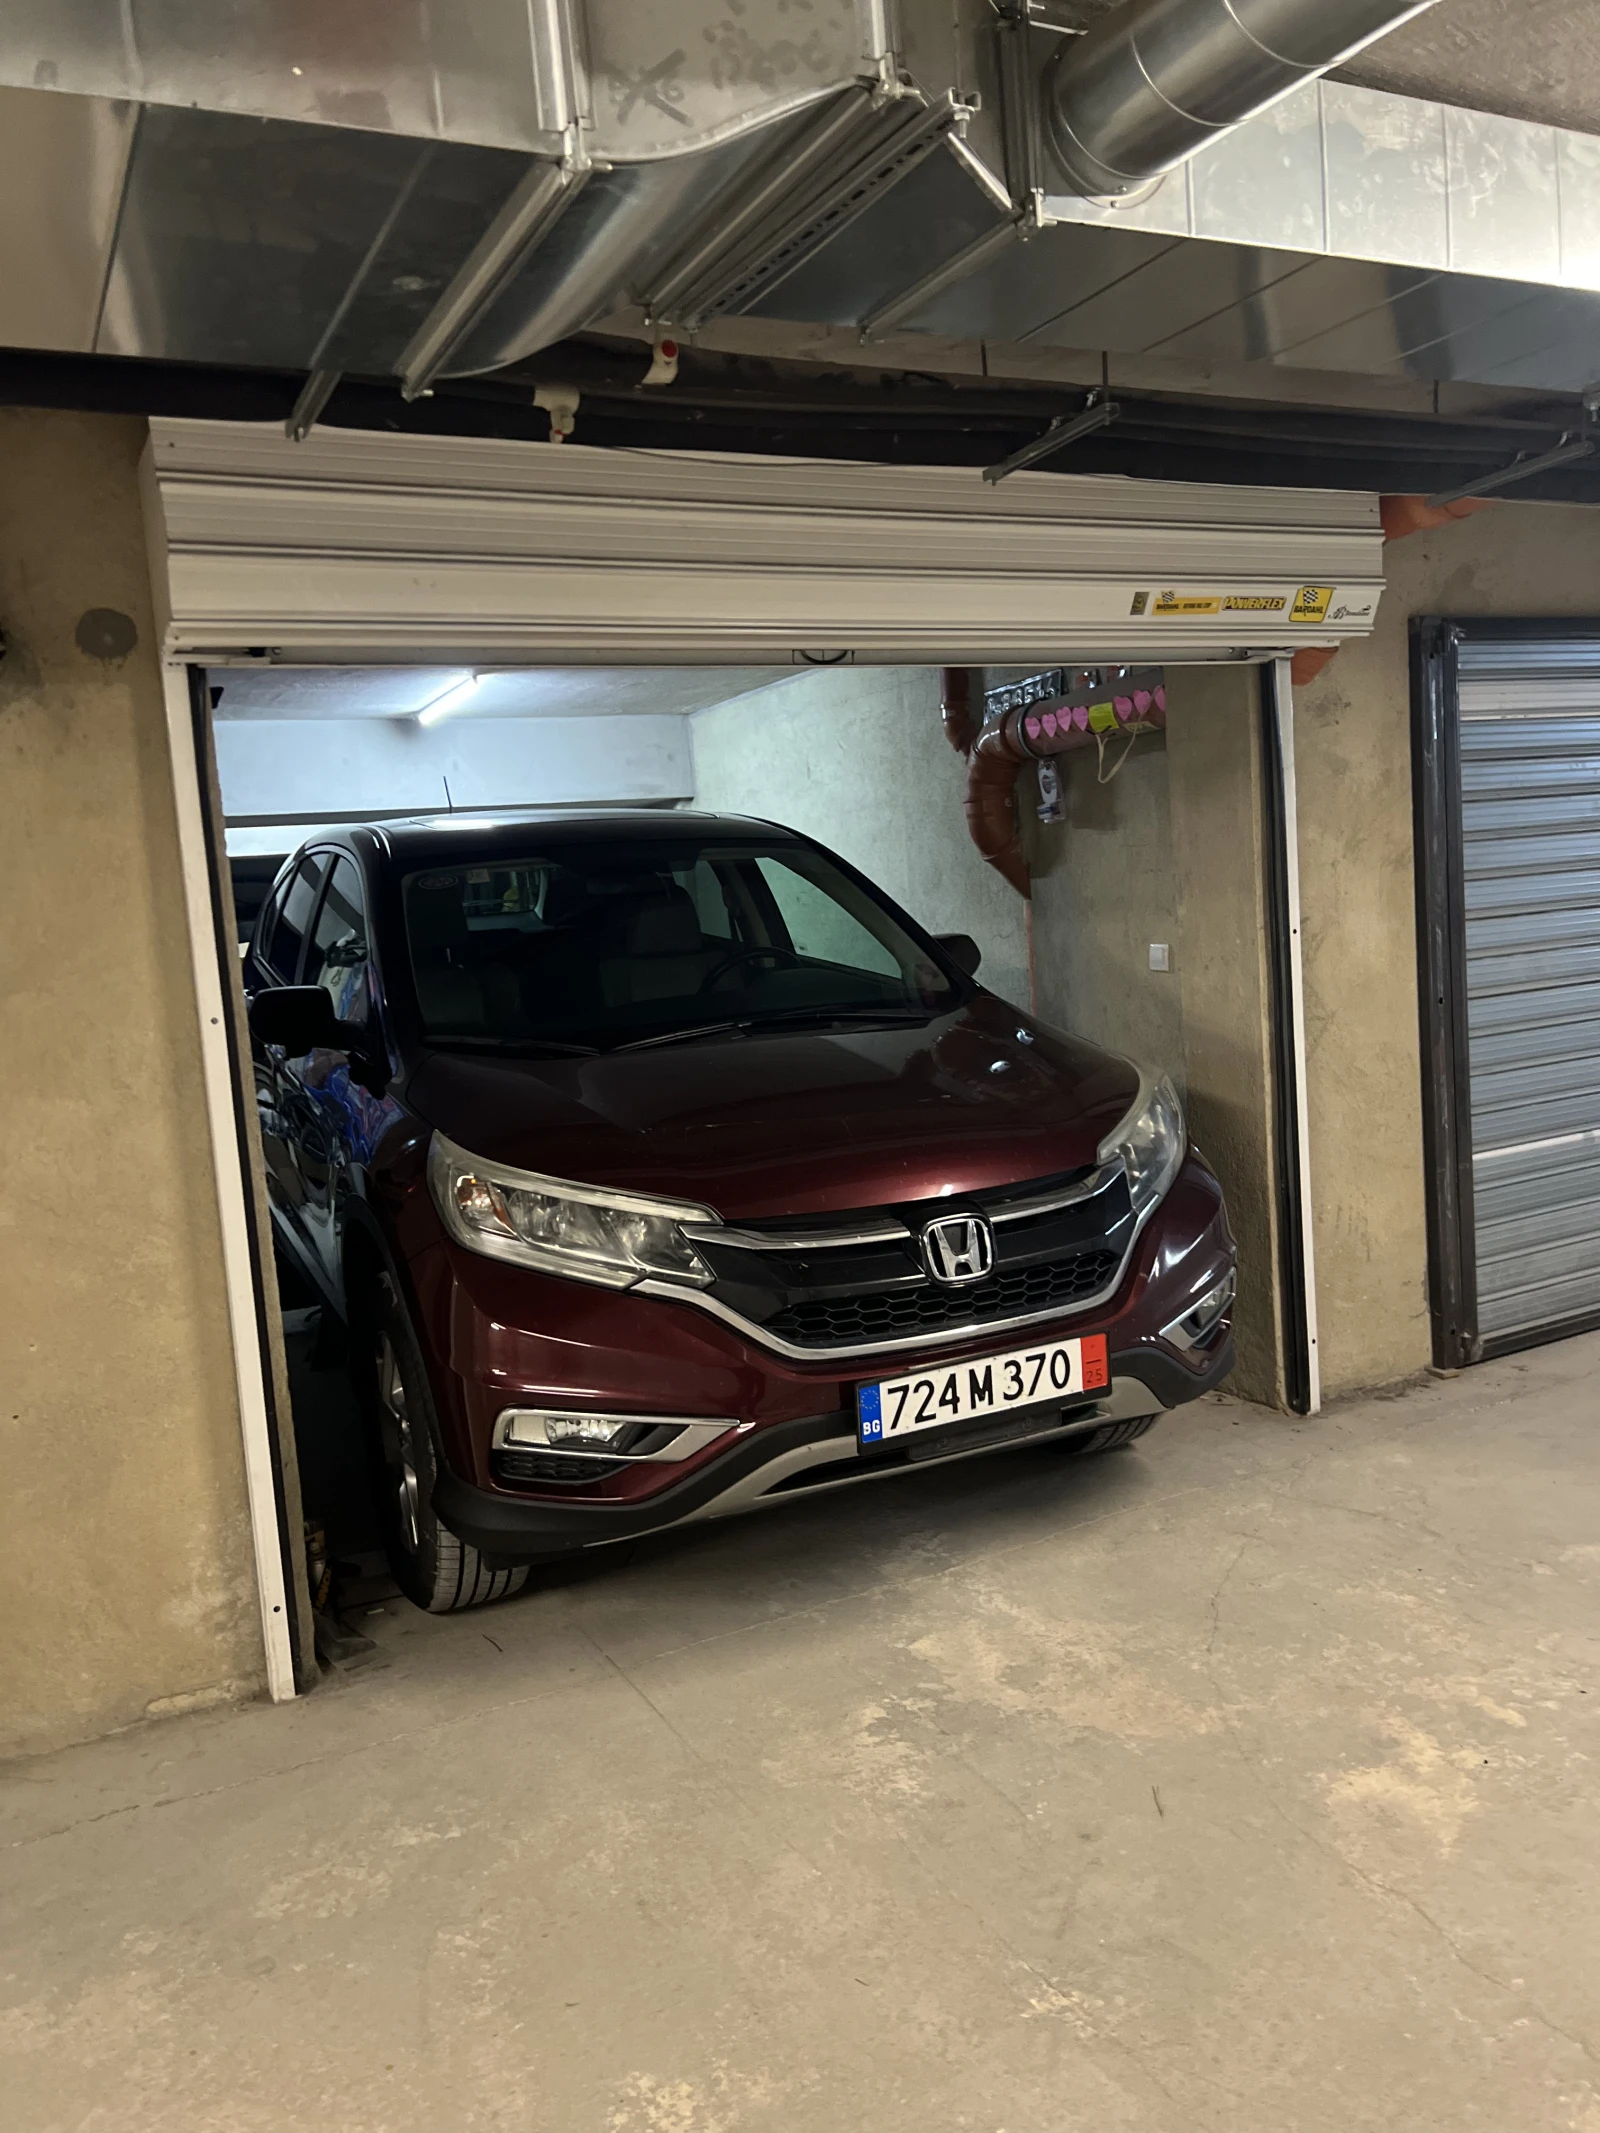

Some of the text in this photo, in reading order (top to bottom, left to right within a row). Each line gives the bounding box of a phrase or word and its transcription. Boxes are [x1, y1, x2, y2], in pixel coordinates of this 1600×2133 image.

[1223, 596, 1285, 610] POWERFLEX
[1294, 605, 1324, 615] BARDAHL
[1086, 1367, 1103, 1384] 25
[887, 1348, 1071, 1430] 724 M 370
[862, 1419, 881, 1436] BG
